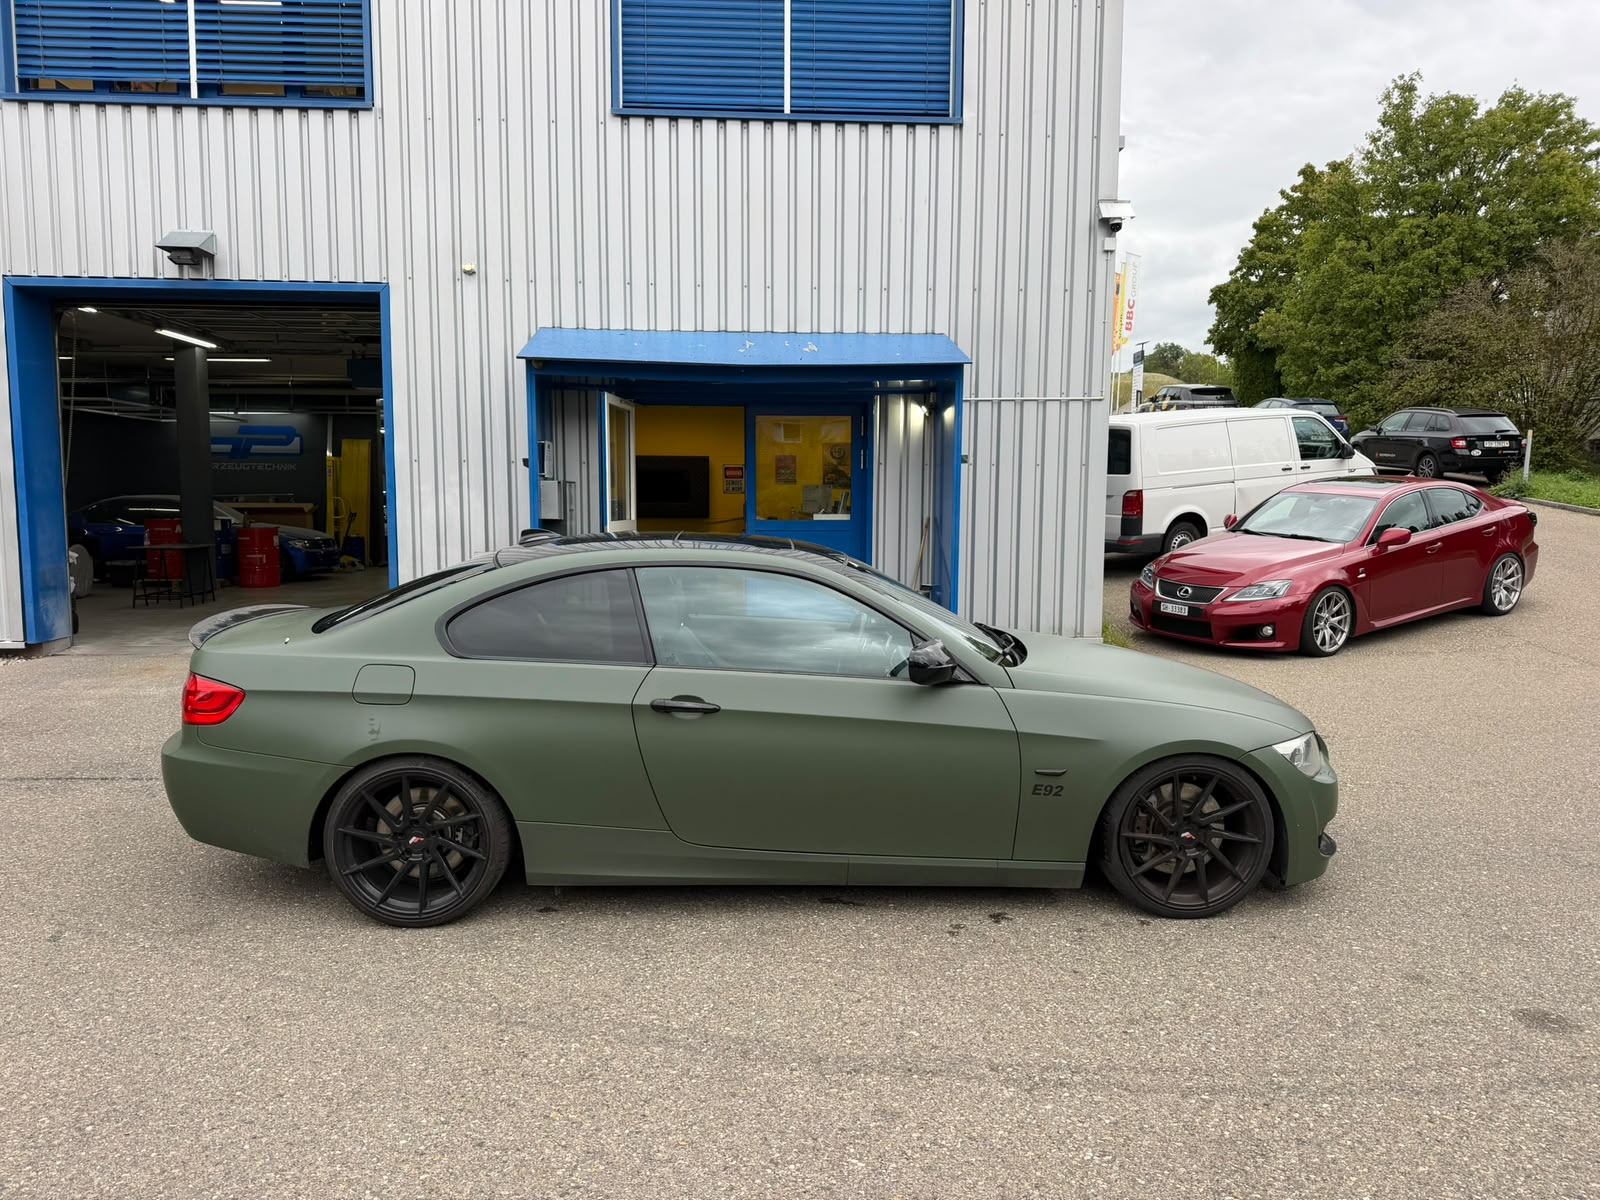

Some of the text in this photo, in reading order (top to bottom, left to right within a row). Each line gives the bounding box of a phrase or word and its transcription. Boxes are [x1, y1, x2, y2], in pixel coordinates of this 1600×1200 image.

[1125, 261, 1139, 332] BBC GROUP
[211, 462, 297, 471] RZEUGTECHNIK
[1031, 783, 1065, 797] E92
